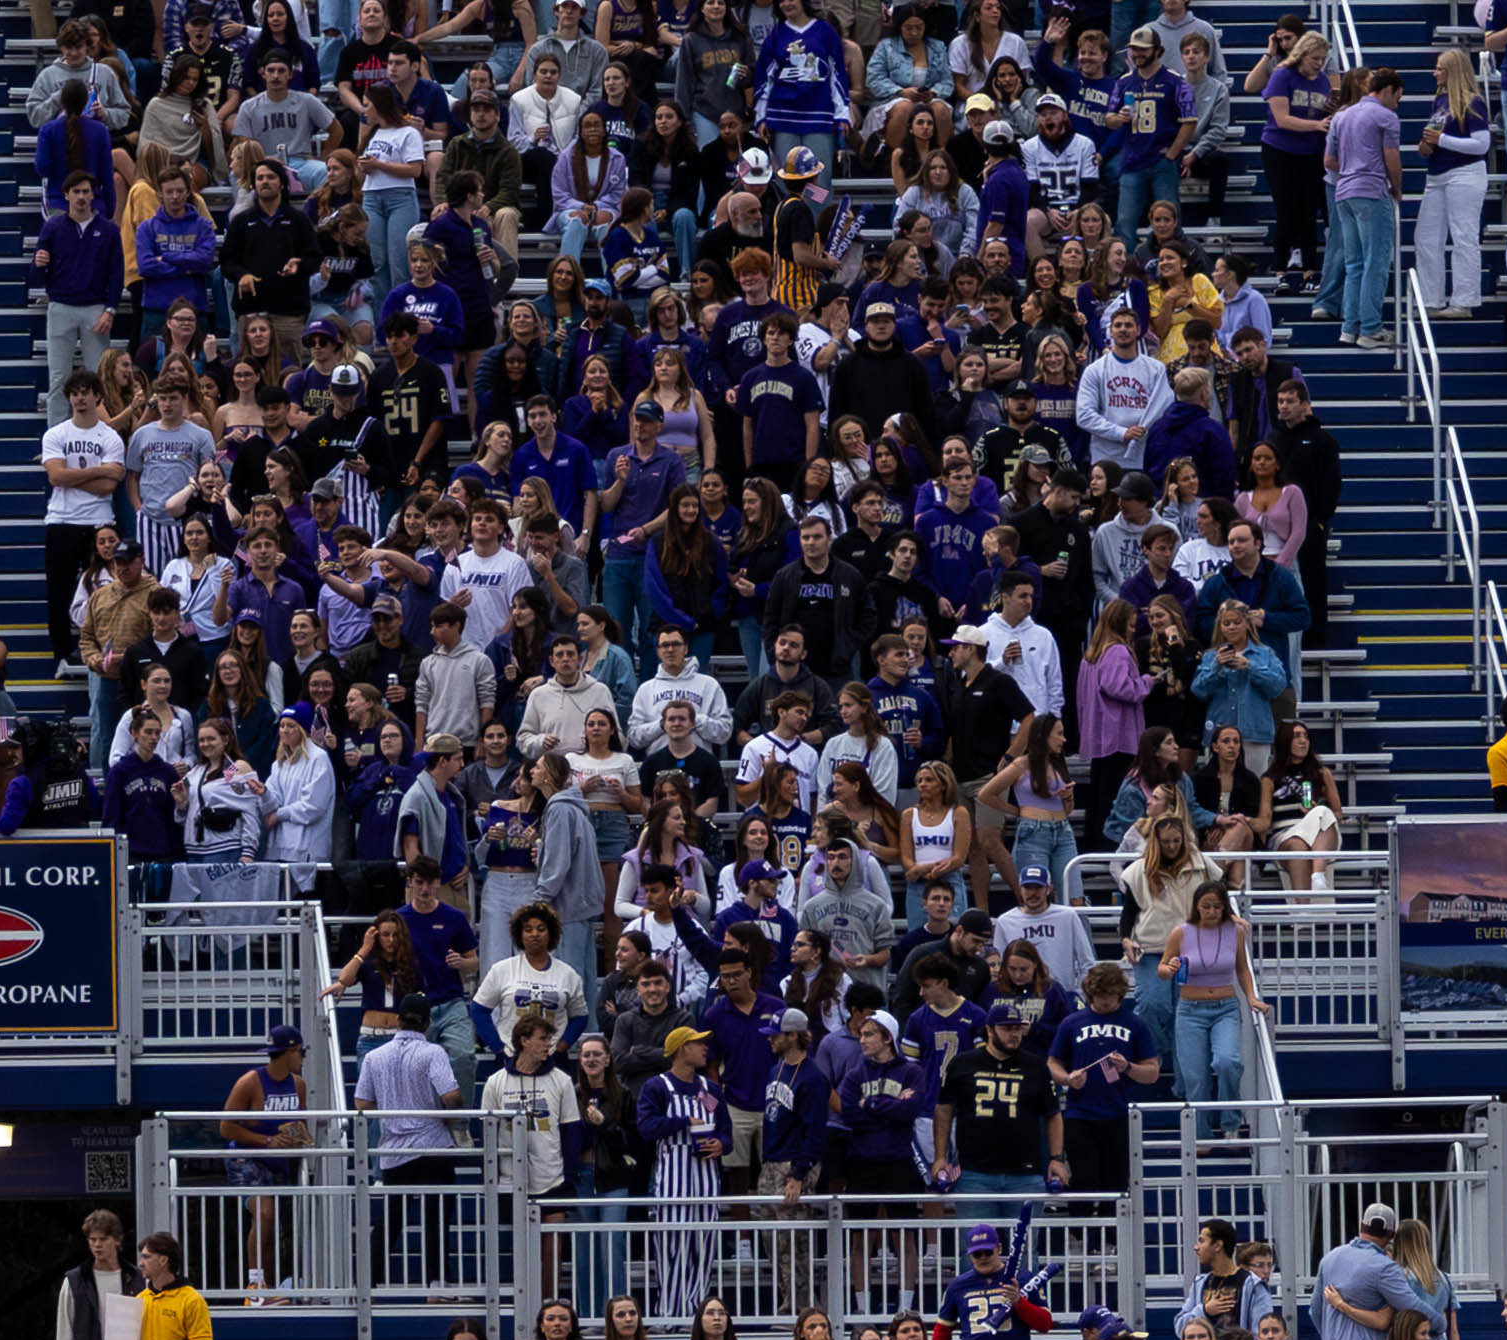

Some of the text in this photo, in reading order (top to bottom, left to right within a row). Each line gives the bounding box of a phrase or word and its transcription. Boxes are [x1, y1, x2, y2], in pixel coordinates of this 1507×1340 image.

[263, 113, 296, 130] JMU
[405, 303, 437, 313] JMU
[799, 338, 813, 355] 25
[1108, 377, 1147, 396] FORTY
[1108, 395, 1147, 409] NINERS
[384, 398, 417, 434] 24
[463, 573, 502, 585] JMU
[44, 780, 82, 802] JMU
[915, 836, 949, 846] JMU
[25, 866, 100, 887] CORP.
[1022, 925, 1055, 939] JMU
[1076, 1024, 1131, 1042] JMU
[935, 1032, 960, 1079] 7
[266, 1095, 298, 1110] JMU
[975, 1078, 1019, 1117] 24
